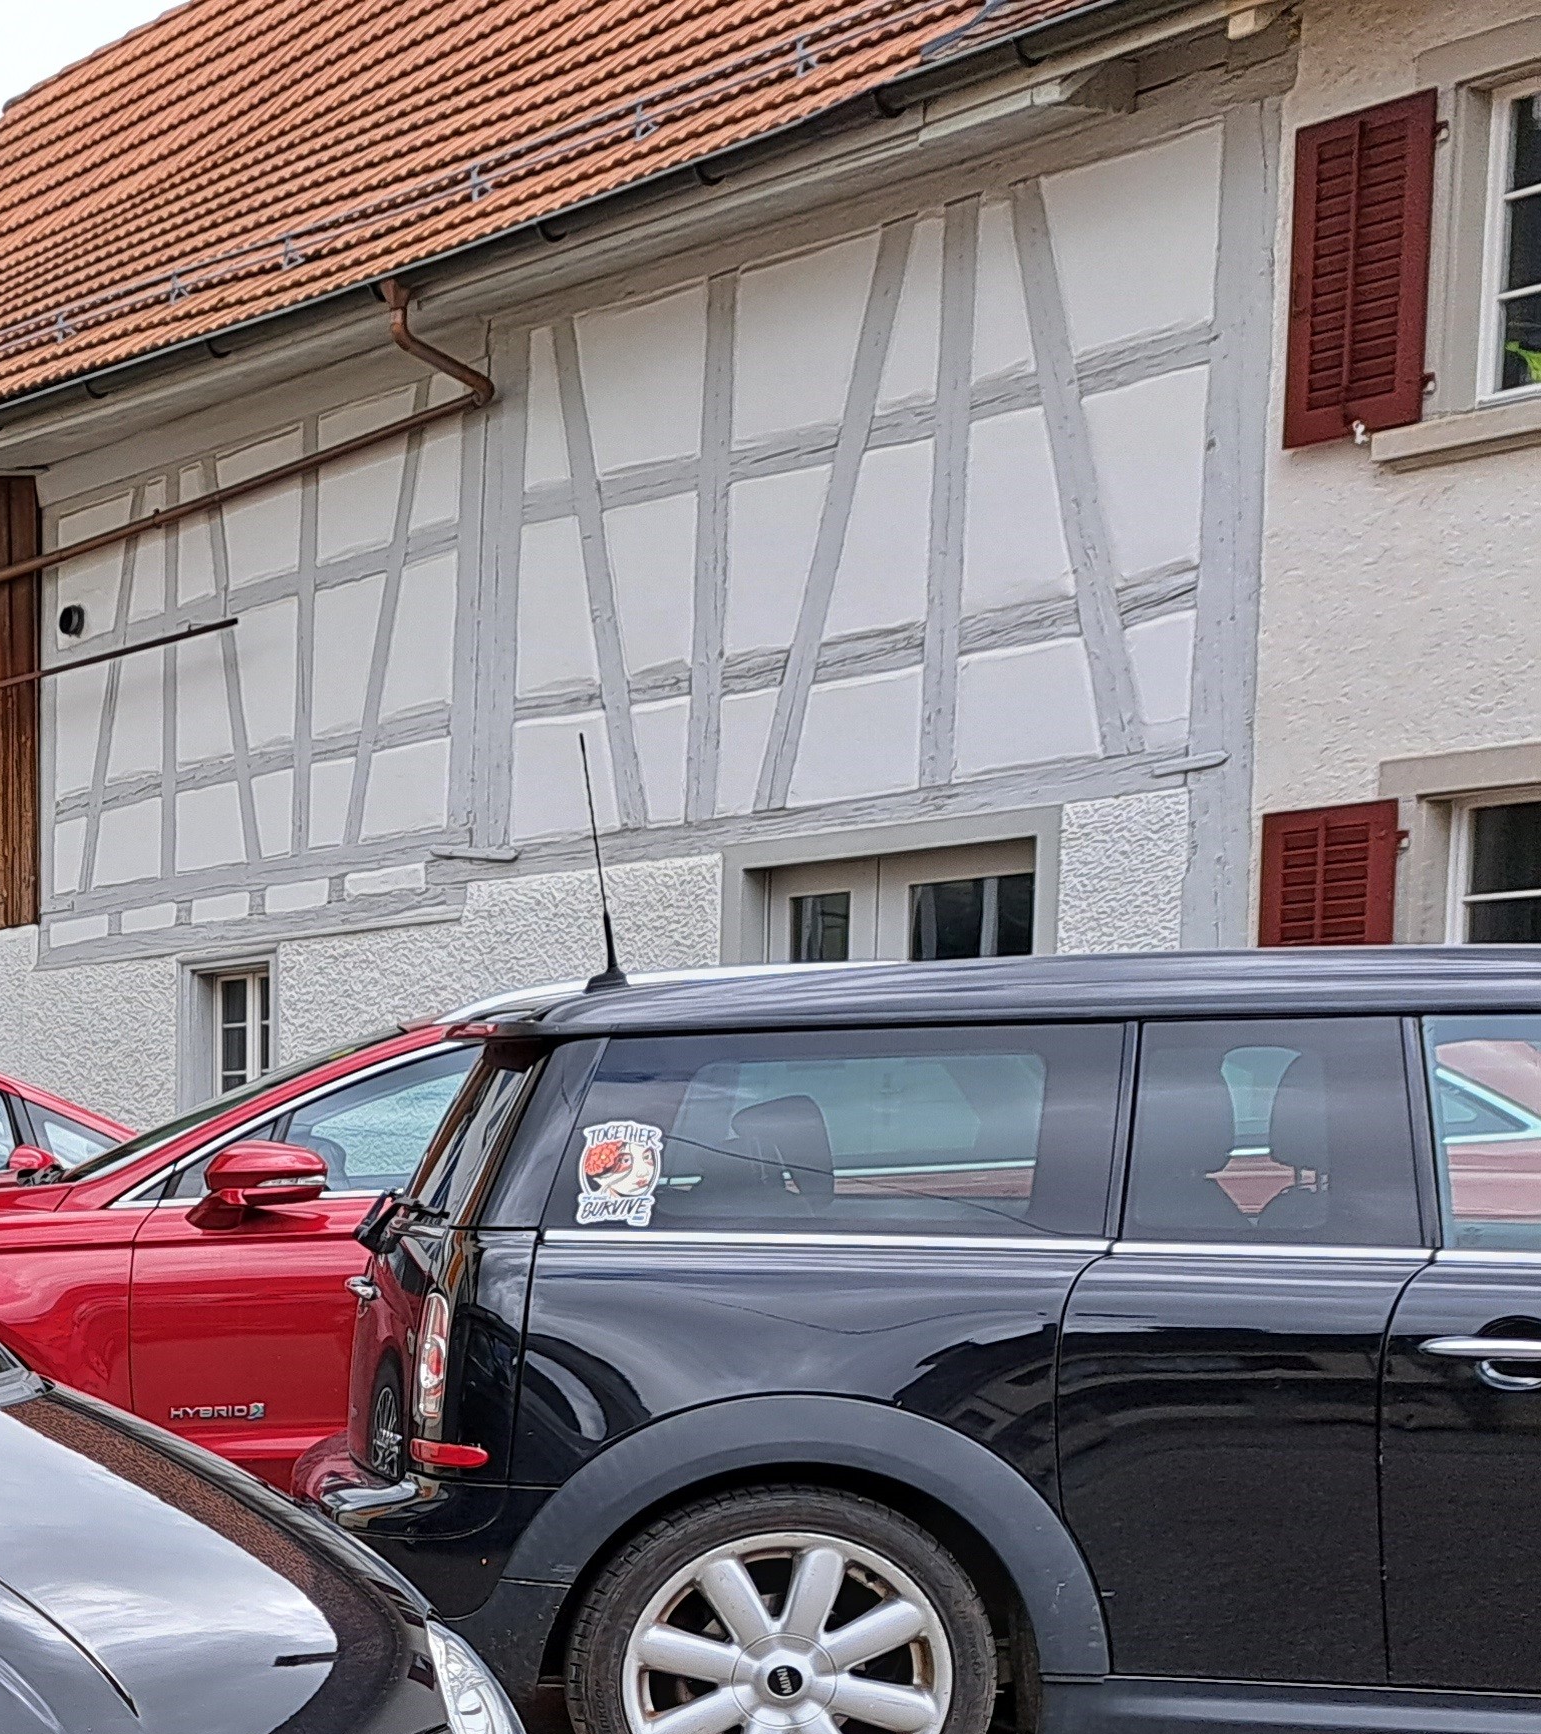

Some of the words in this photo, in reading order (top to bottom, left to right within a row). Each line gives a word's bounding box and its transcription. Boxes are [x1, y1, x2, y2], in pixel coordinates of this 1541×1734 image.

[588, 1124, 657, 1147] TOGETHER
[170, 1405, 248, 1419] HYBRID
[776, 1667, 793, 1694] MINI
